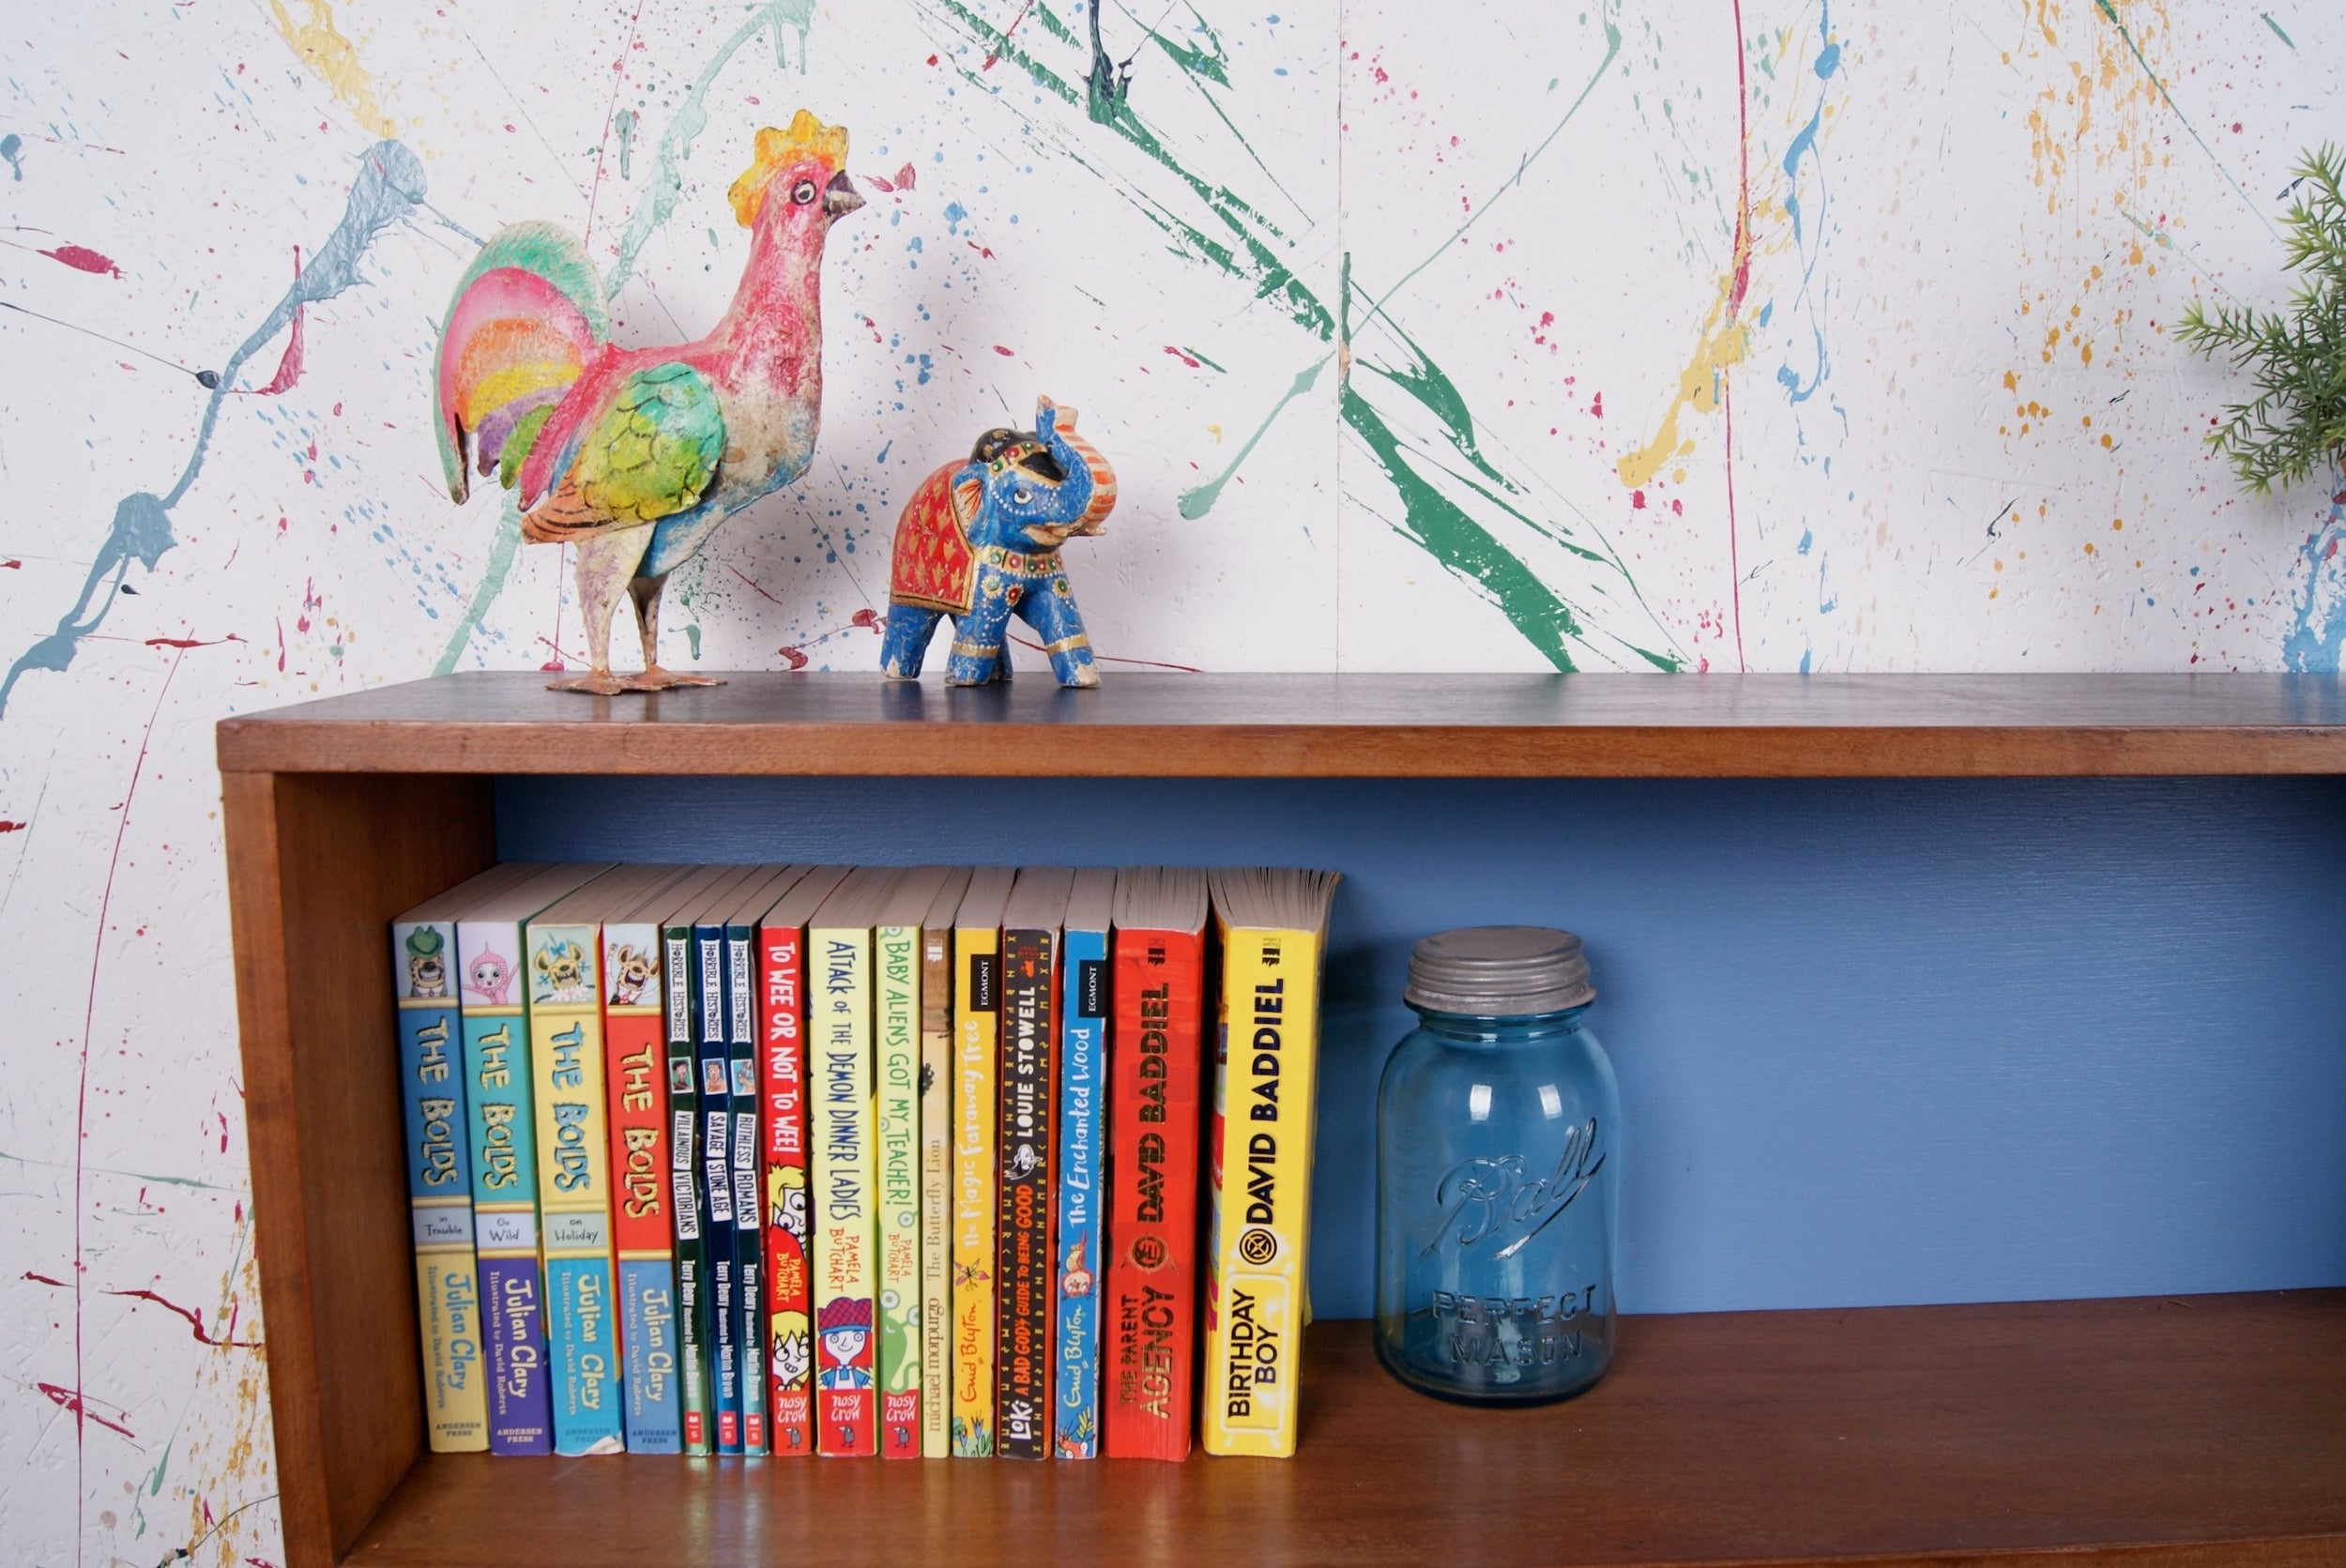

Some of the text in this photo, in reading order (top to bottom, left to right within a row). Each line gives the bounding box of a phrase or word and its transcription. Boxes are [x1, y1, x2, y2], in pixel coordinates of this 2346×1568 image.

[671, 943, 686, 1039] HORRIBLE HISTORIES
[704, 944, 720, 1039] HORRIBLE HISTORIES
[733, 944, 747, 1039] HORRIBLE HISTORIES
[981, 960, 989, 1006] EGMONT
[1089, 966, 1097, 1012] EGMONT
[769, 942, 800, 1153] TO WEE OR NOT TO WEE!
[1016, 986, 1035, 1137] LOUIE STOWELL
[1139, 983, 1169, 1123] BADDIEL
[1250, 978, 1284, 1121] BADDIEL
[826, 941, 861, 1221] ATTACK OF THE DEMON DINNER LADIES
[885, 940, 913, 1206] BABY ALIENS GOT MY TEACHER!
[416, 1015, 458, 1187] THE BOLDS
[478, 1023, 518, 1190] THE BOLDS
[552, 1021, 590, 1192] THE BOLDS
[619, 1043, 660, 1219] THE BOLDS
[676, 1114, 692, 1165] VILLAINOUS
[710, 1116, 725, 1152] SAVAGE
[736, 1116, 754, 1164] RUTHLESS
[959, 1020, 984, 1249] The Magic Faraway Tree
[1067, 1028, 1090, 1228] The Enchanted Wood
[708, 1164, 729, 1213] STONE AGE
[737, 1174, 756, 1224] ROMANS
[1137, 1133, 1165, 1223] DAVID
[1246, 1133, 1276, 1225] DAVID
[1416, 1117, 1607, 1267] Ball
[675, 1175, 696, 1234] VICTORIANS
[926, 1139, 945, 1280] The Butterfly Lion
[1015, 1185, 1033, 1228] GOOD
[425, 1225, 463, 1236] Trouble
[490, 1228, 519, 1241] Wild
[555, 1229, 599, 1243] Holiday
[1017, 1230, 1030, 1262] BEING
[681, 1260, 695, 1281] Terry
[716, 1260, 730, 1282] Terry
[743, 1263, 757, 1285] Terry
[776, 1252, 789, 1302] BUTCHART
[789, 1258, 802, 1297] PAMELA
[828, 1227, 844, 1292] BUTCHART
[845, 1235, 861, 1284] PAMELA
[888, 1233, 900, 1283] BUTCHART
[901, 1239, 913, 1282] PAMELA
[1017, 1265, 1029, 1278] TO
[561, 1271, 572, 1328] Illustrated
[628, 1272, 637, 1331] Illustrated
[682, 1283, 696, 1306] Deary
[717, 1283, 731, 1306] Deary
[744, 1286, 758, 1310] Deary
[1016, 1281, 1030, 1315] GUIDE
[1433, 1283, 1597, 1325] PERFECT
[445, 1272, 476, 1391] Julian Clary
[490, 1271, 507, 1415] Illustrated by David Roberts
[504, 1278, 537, 1398] Julian Clary
[576, 1274, 605, 1410] Julian Clary
[643, 1288, 673, 1402] Julian Clary
[960, 1302, 981, 1359] Blyton
[1064, 1305, 1083, 1361] Blyton
[1119, 1294, 1139, 1406] THE PARENT
[1139, 1286, 1175, 1419] AGENCY
[1227, 1287, 1256, 1418] BIRTHDAY
[1254, 1325, 1278, 1385] BOY
[1450, 1330, 1583, 1364] MASON
[565, 1343, 574, 1375] David
[631, 1345, 640, 1374] David
[720, 1345, 733, 1371] Martin
[925, 1298, 945, 1433] michael morpurgo
[1014, 1358, 1030, 1383] BAD
[567, 1377, 576, 1416] Roberts
[632, 1376, 642, 1417] Roberts
[721, 1372, 735, 1398] Brown
[777, 1396, 807, 1408] nosy
[832, 1394, 861, 1407] nosy
[887, 1394, 917, 1407] nosy
[1014, 1385, 1028, 1396] A
